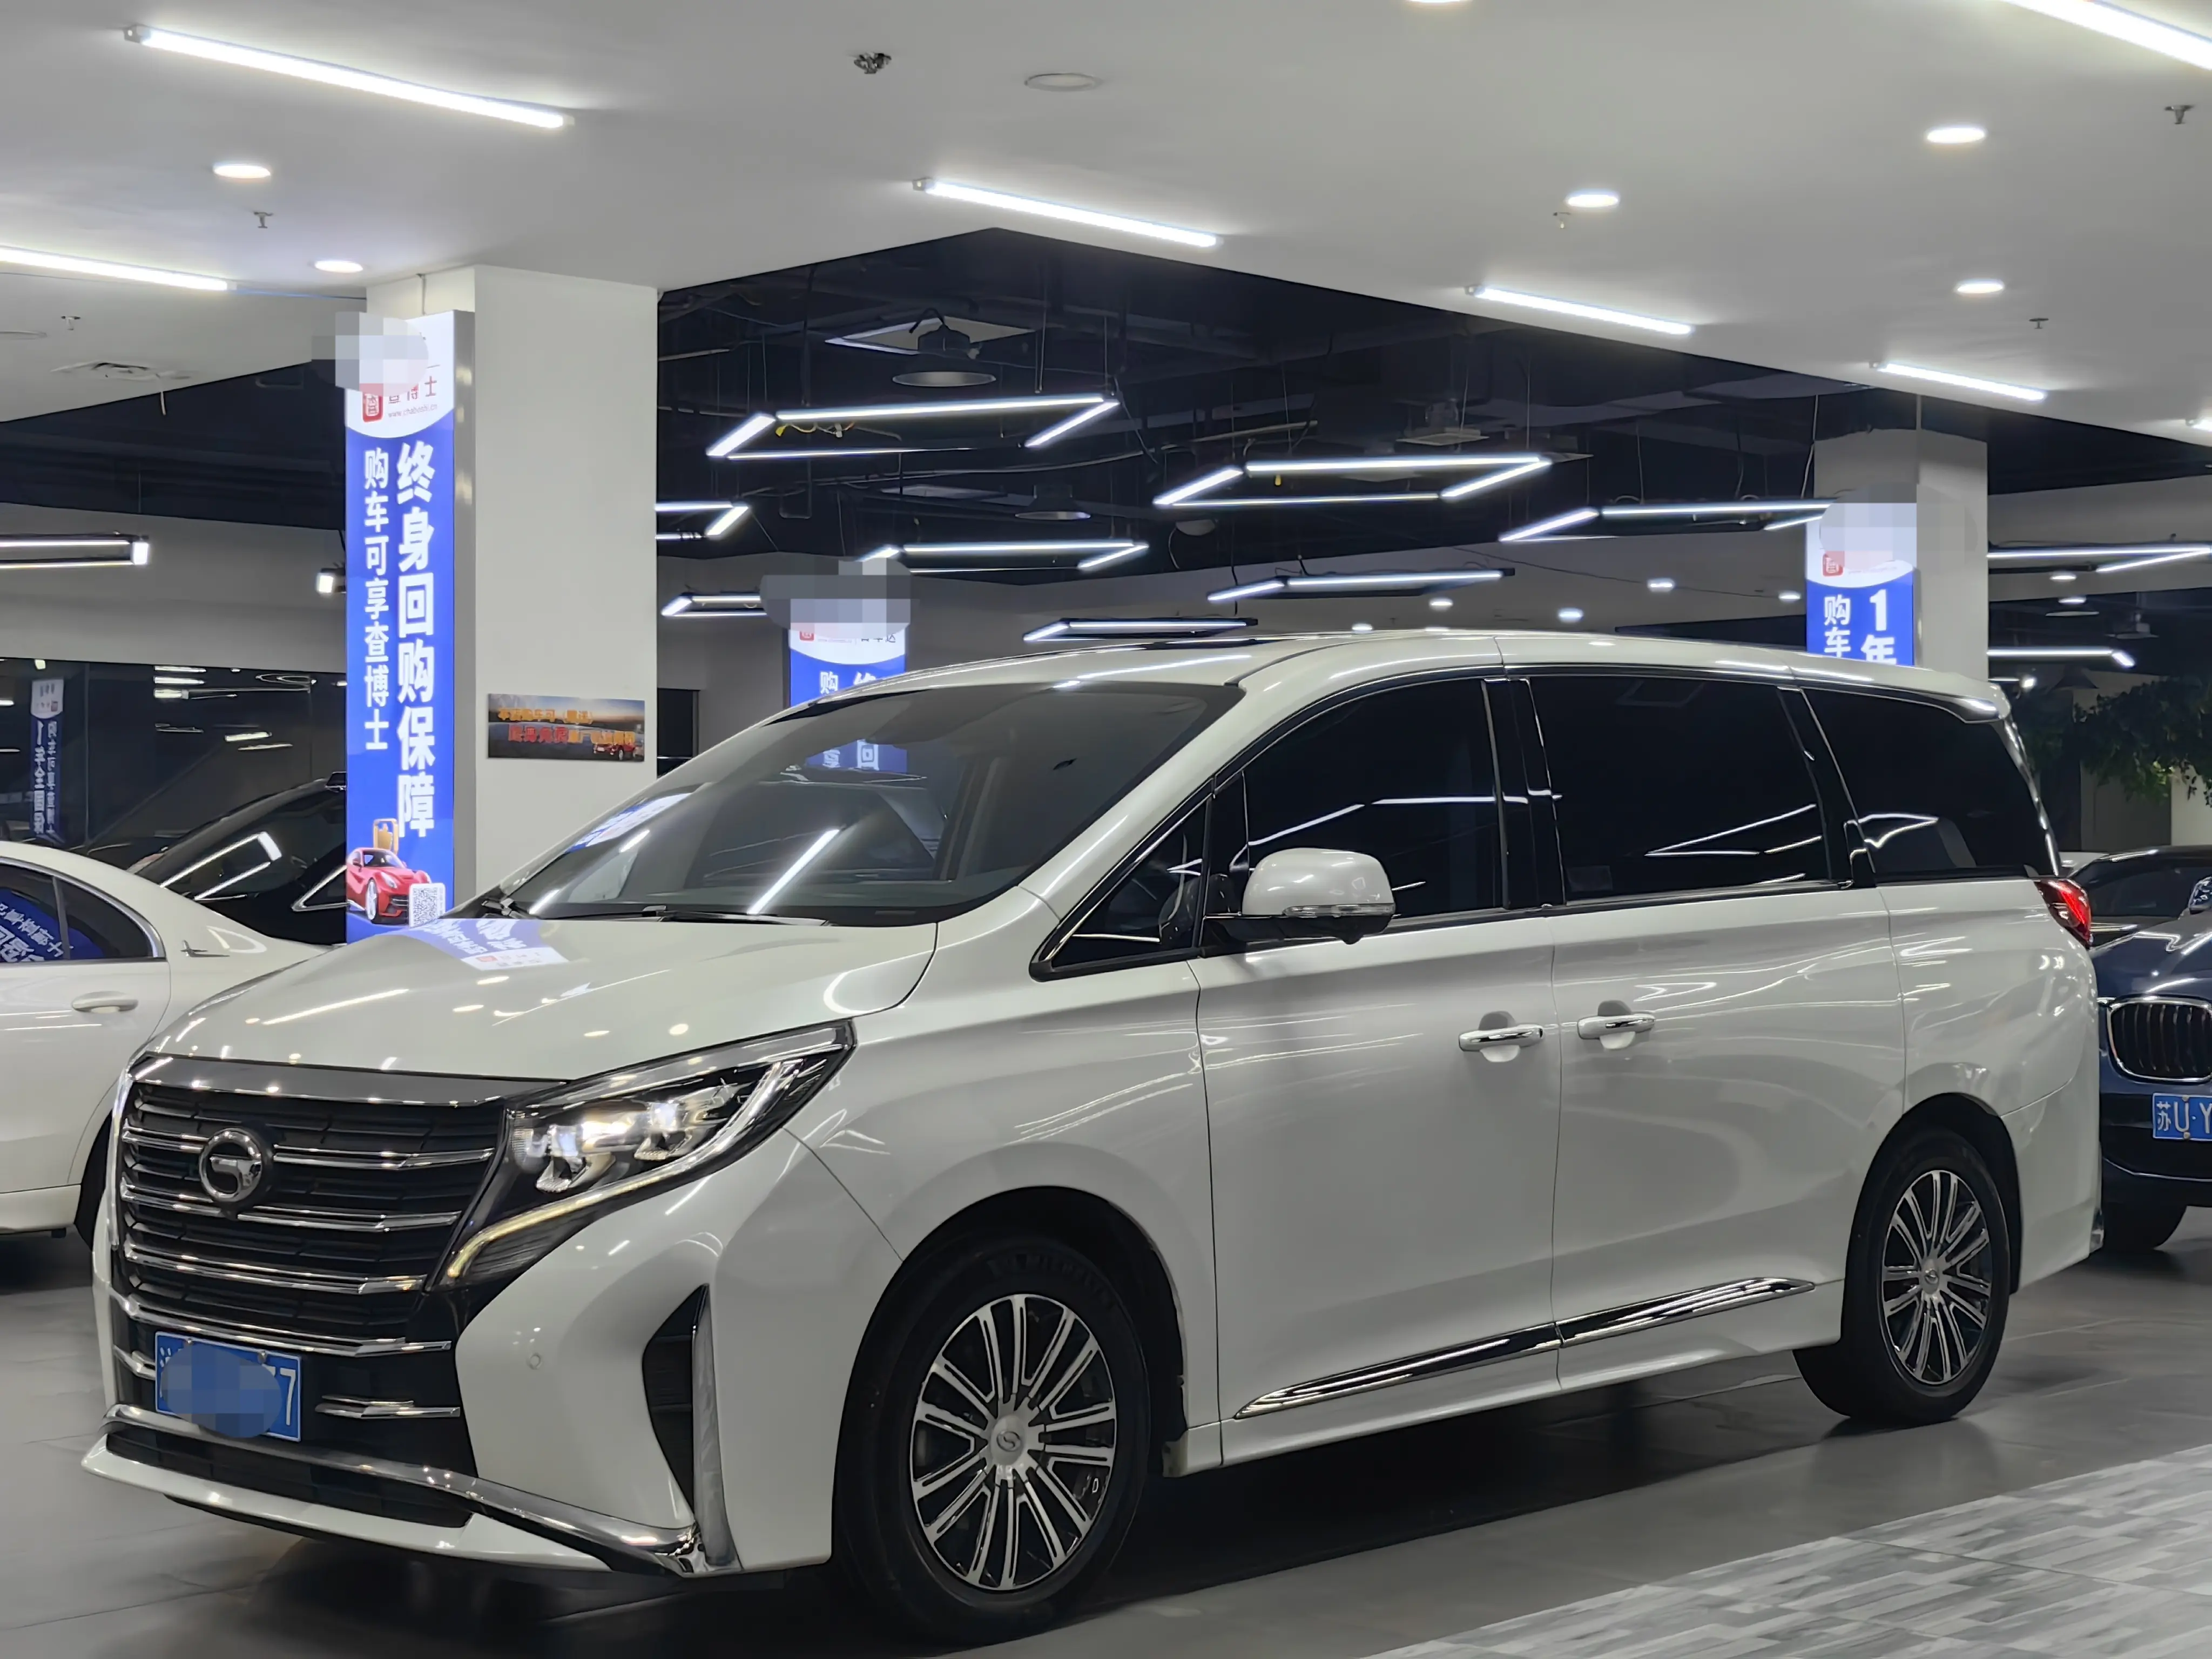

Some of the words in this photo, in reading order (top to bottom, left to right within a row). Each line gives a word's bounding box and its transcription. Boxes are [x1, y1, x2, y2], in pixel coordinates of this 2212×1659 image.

[363, 447, 389, 750] 购车可享查博士
[396, 440, 436, 838] 终身回购保障
[820, 671, 839, 694] 购
[1823, 594, 1851, 658] 购车
